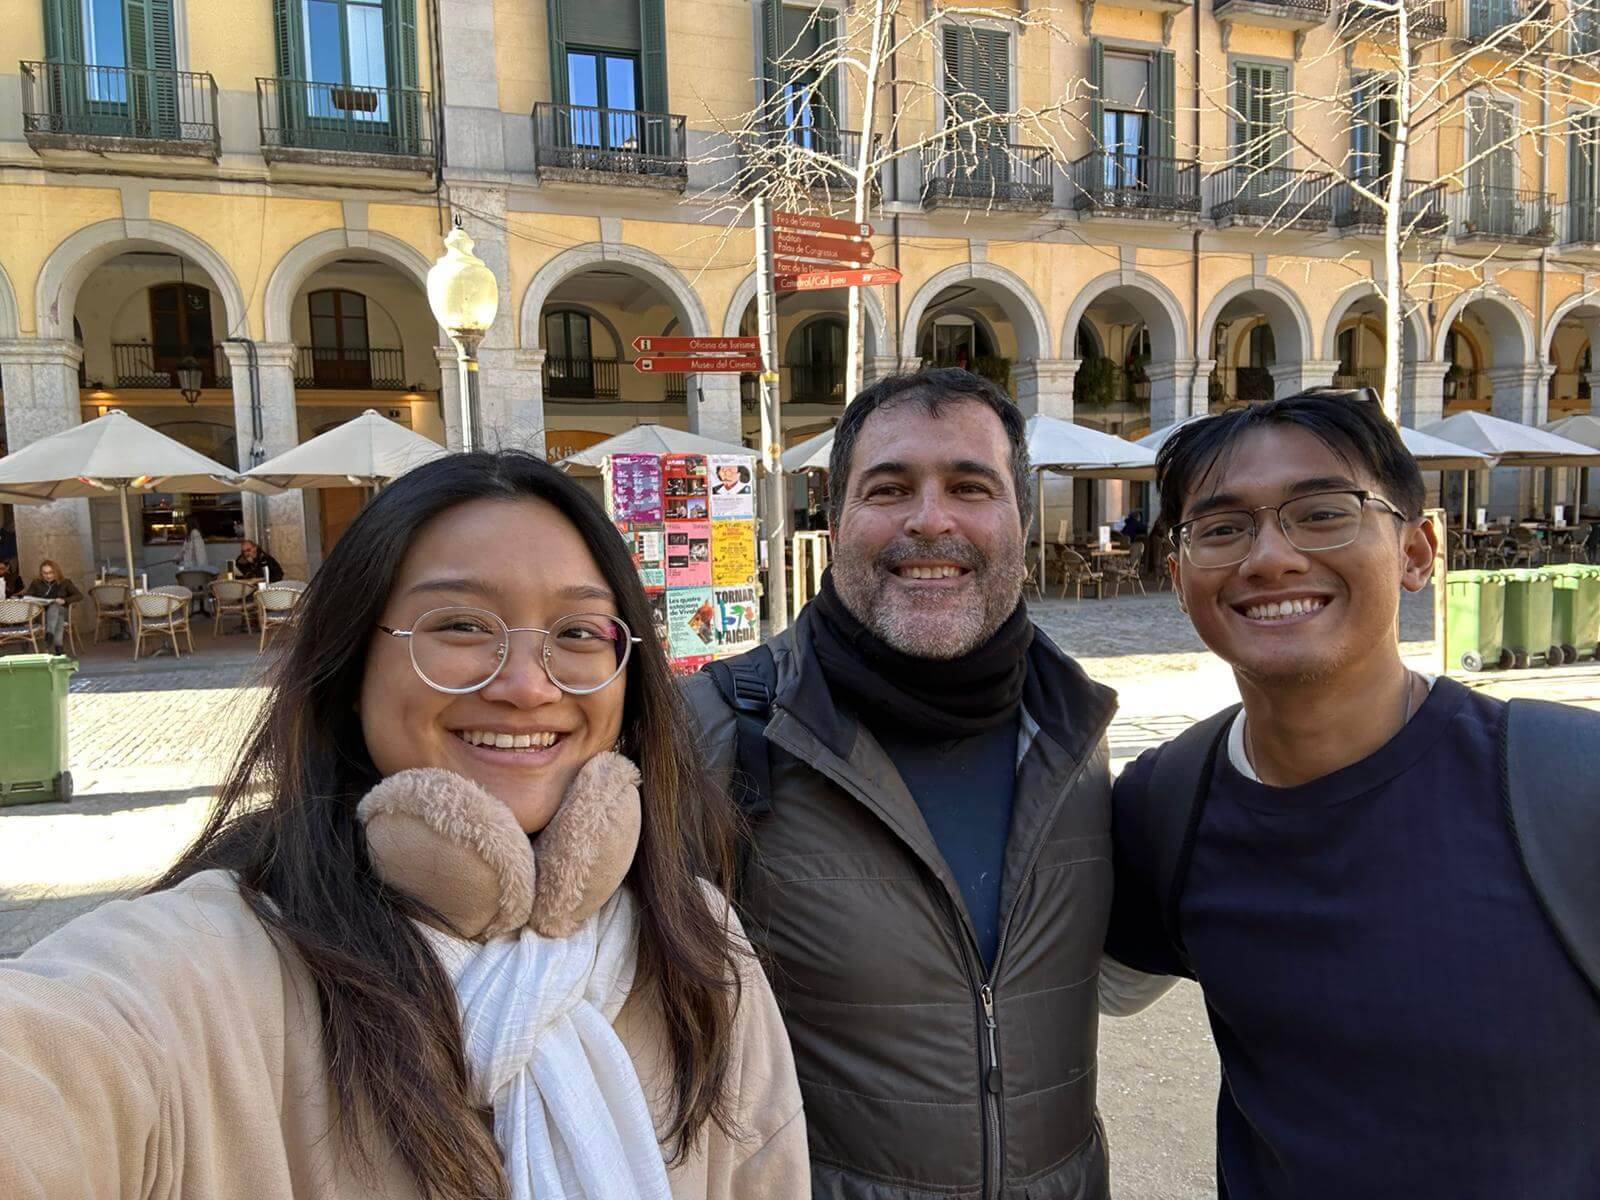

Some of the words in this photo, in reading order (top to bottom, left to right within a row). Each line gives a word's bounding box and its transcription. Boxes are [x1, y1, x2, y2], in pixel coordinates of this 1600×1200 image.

[799, 217, 821, 228] Girona
[690, 340, 717, 349] Oficina
[719, 340, 728, 349] de
[691, 360, 714, 369] Museu
[716, 360, 728, 369] del
[729, 360, 757, 369] Cinema
[715, 589, 755, 605] TORNAR
